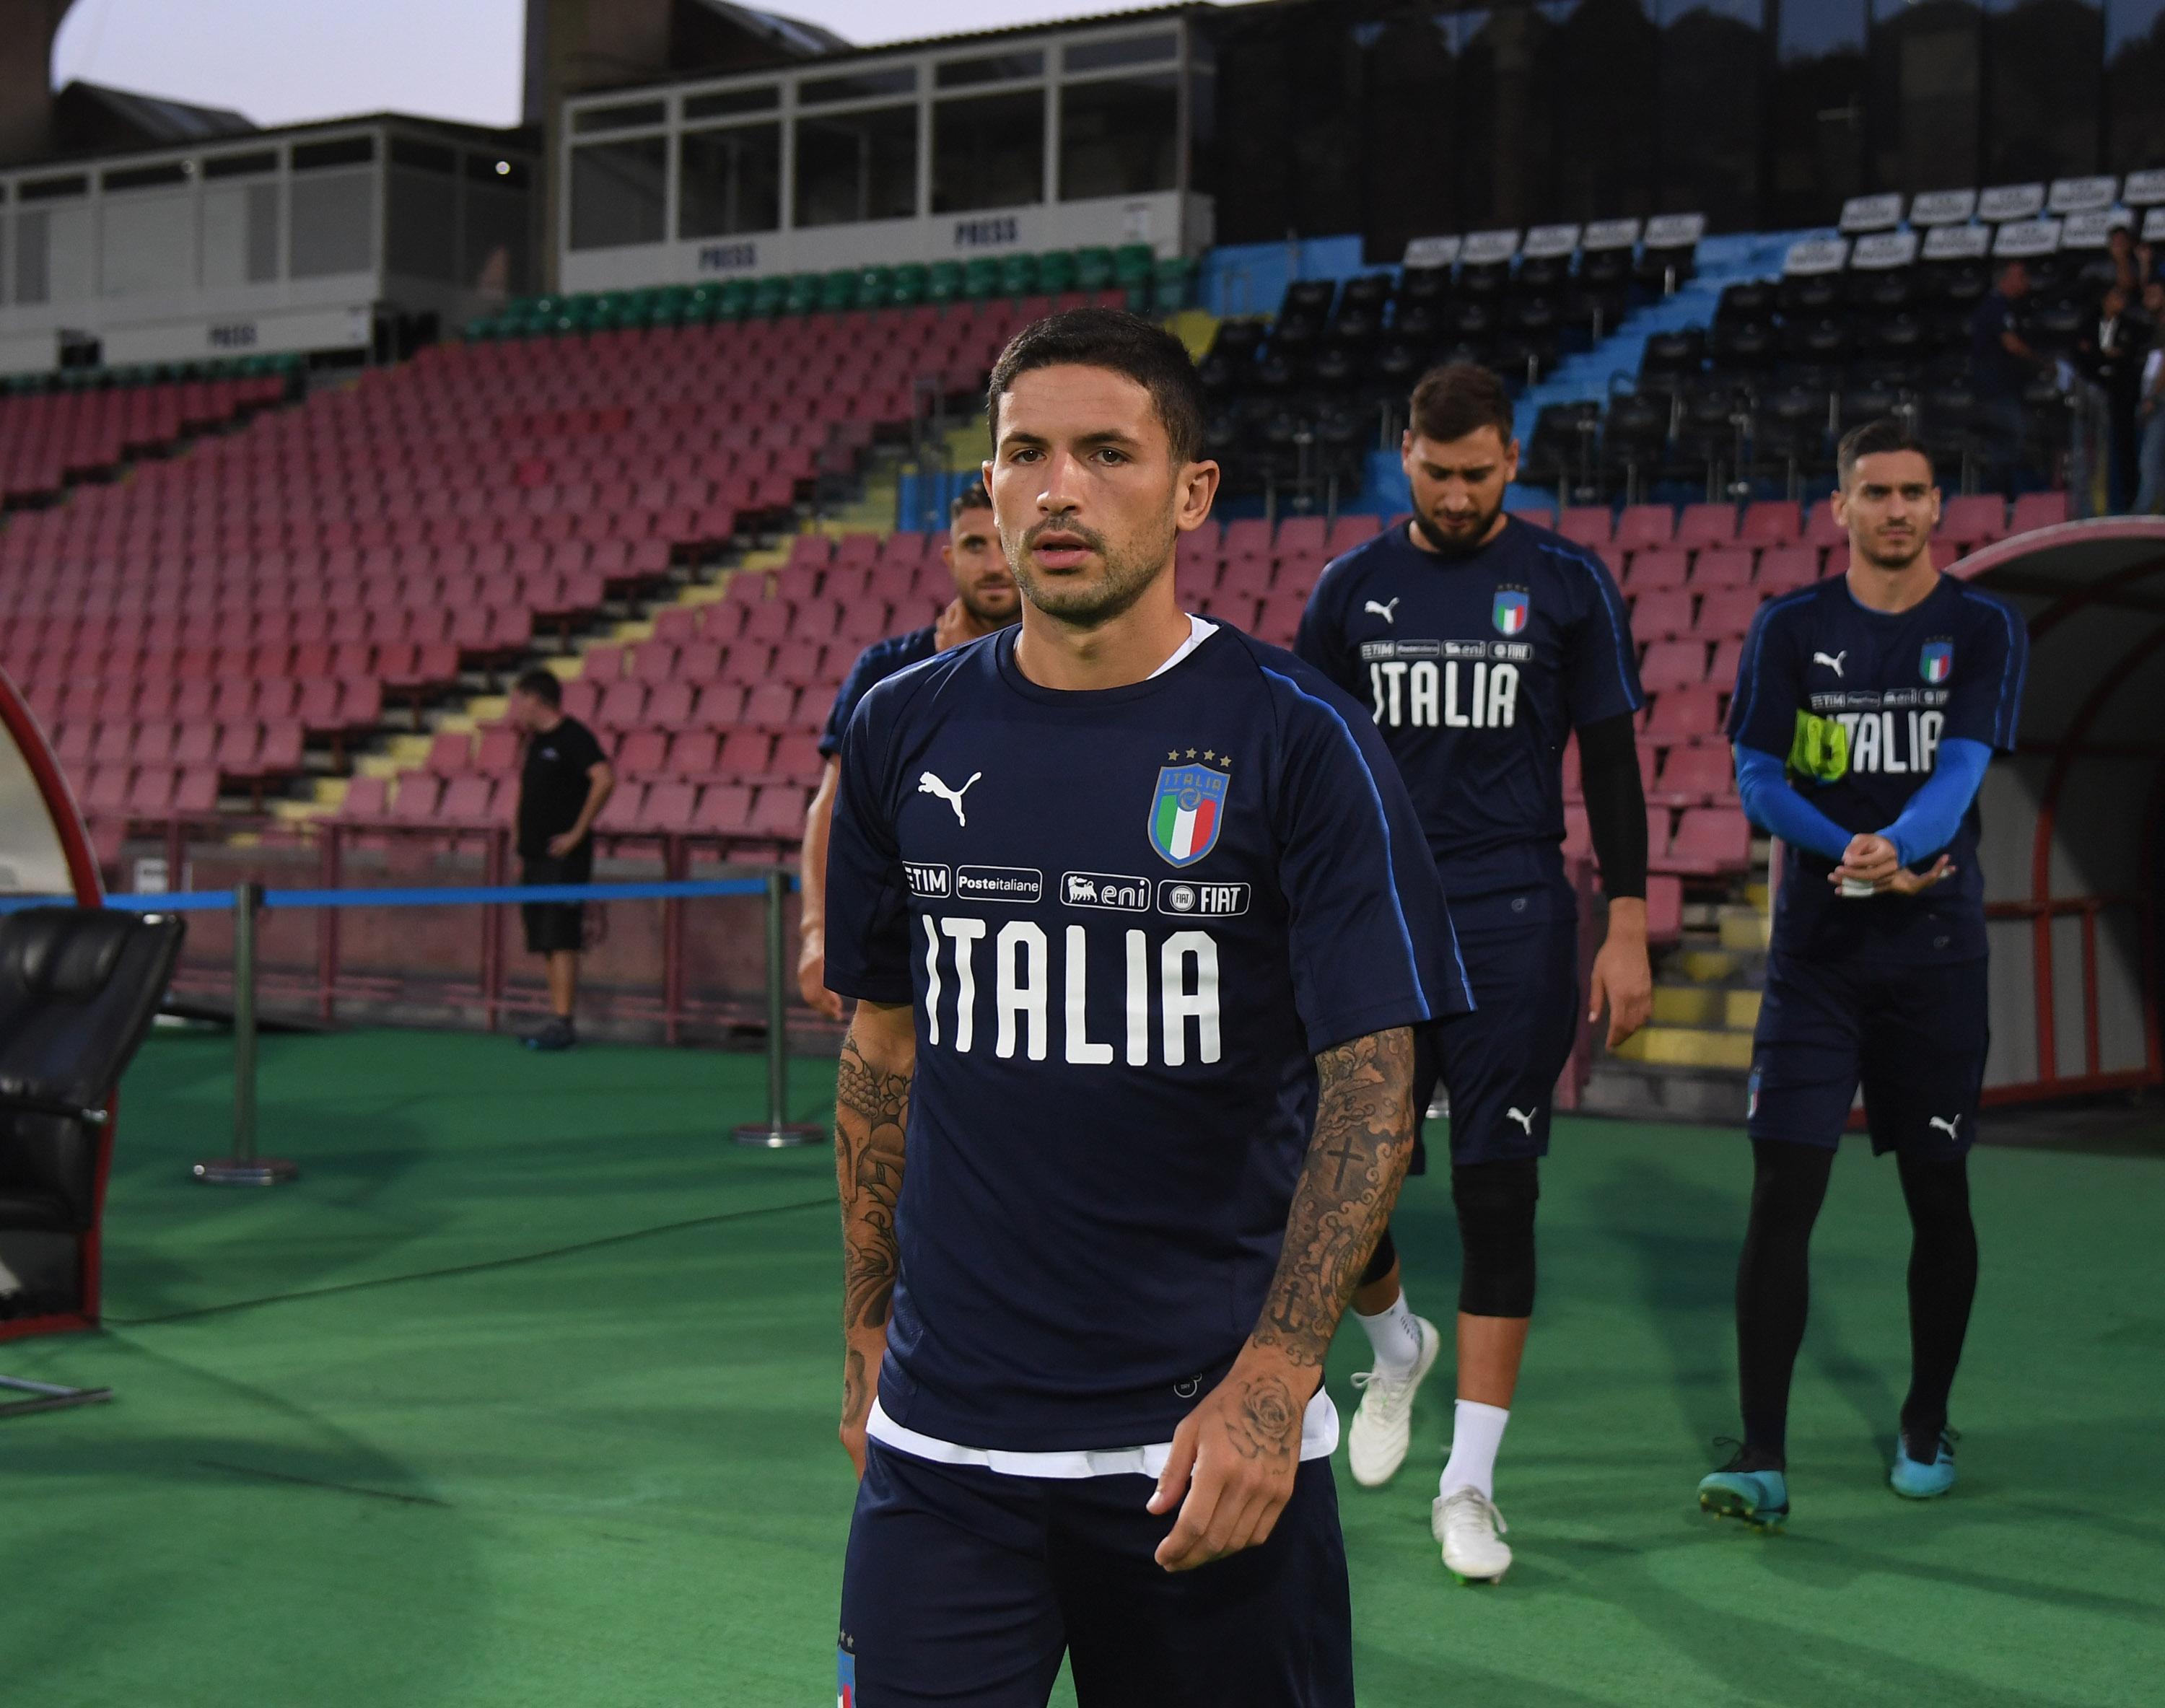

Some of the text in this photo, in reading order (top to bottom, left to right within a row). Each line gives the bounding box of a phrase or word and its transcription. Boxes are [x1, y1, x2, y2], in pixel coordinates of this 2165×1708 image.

[955, 219, 1018, 245] PRESS
[1370, 661, 1519, 728] ITALIA
[1827, 710, 1946, 774] TALIA
[1165, 773, 1223, 792] ITALIA
[913, 868, 946, 893] TIM
[1101, 880, 1145, 907] eni
[1176, 893, 1189, 904] FIAT
[1201, 887, 1241, 913] FIAT
[922, 914, 1222, 1067] ITALIA
